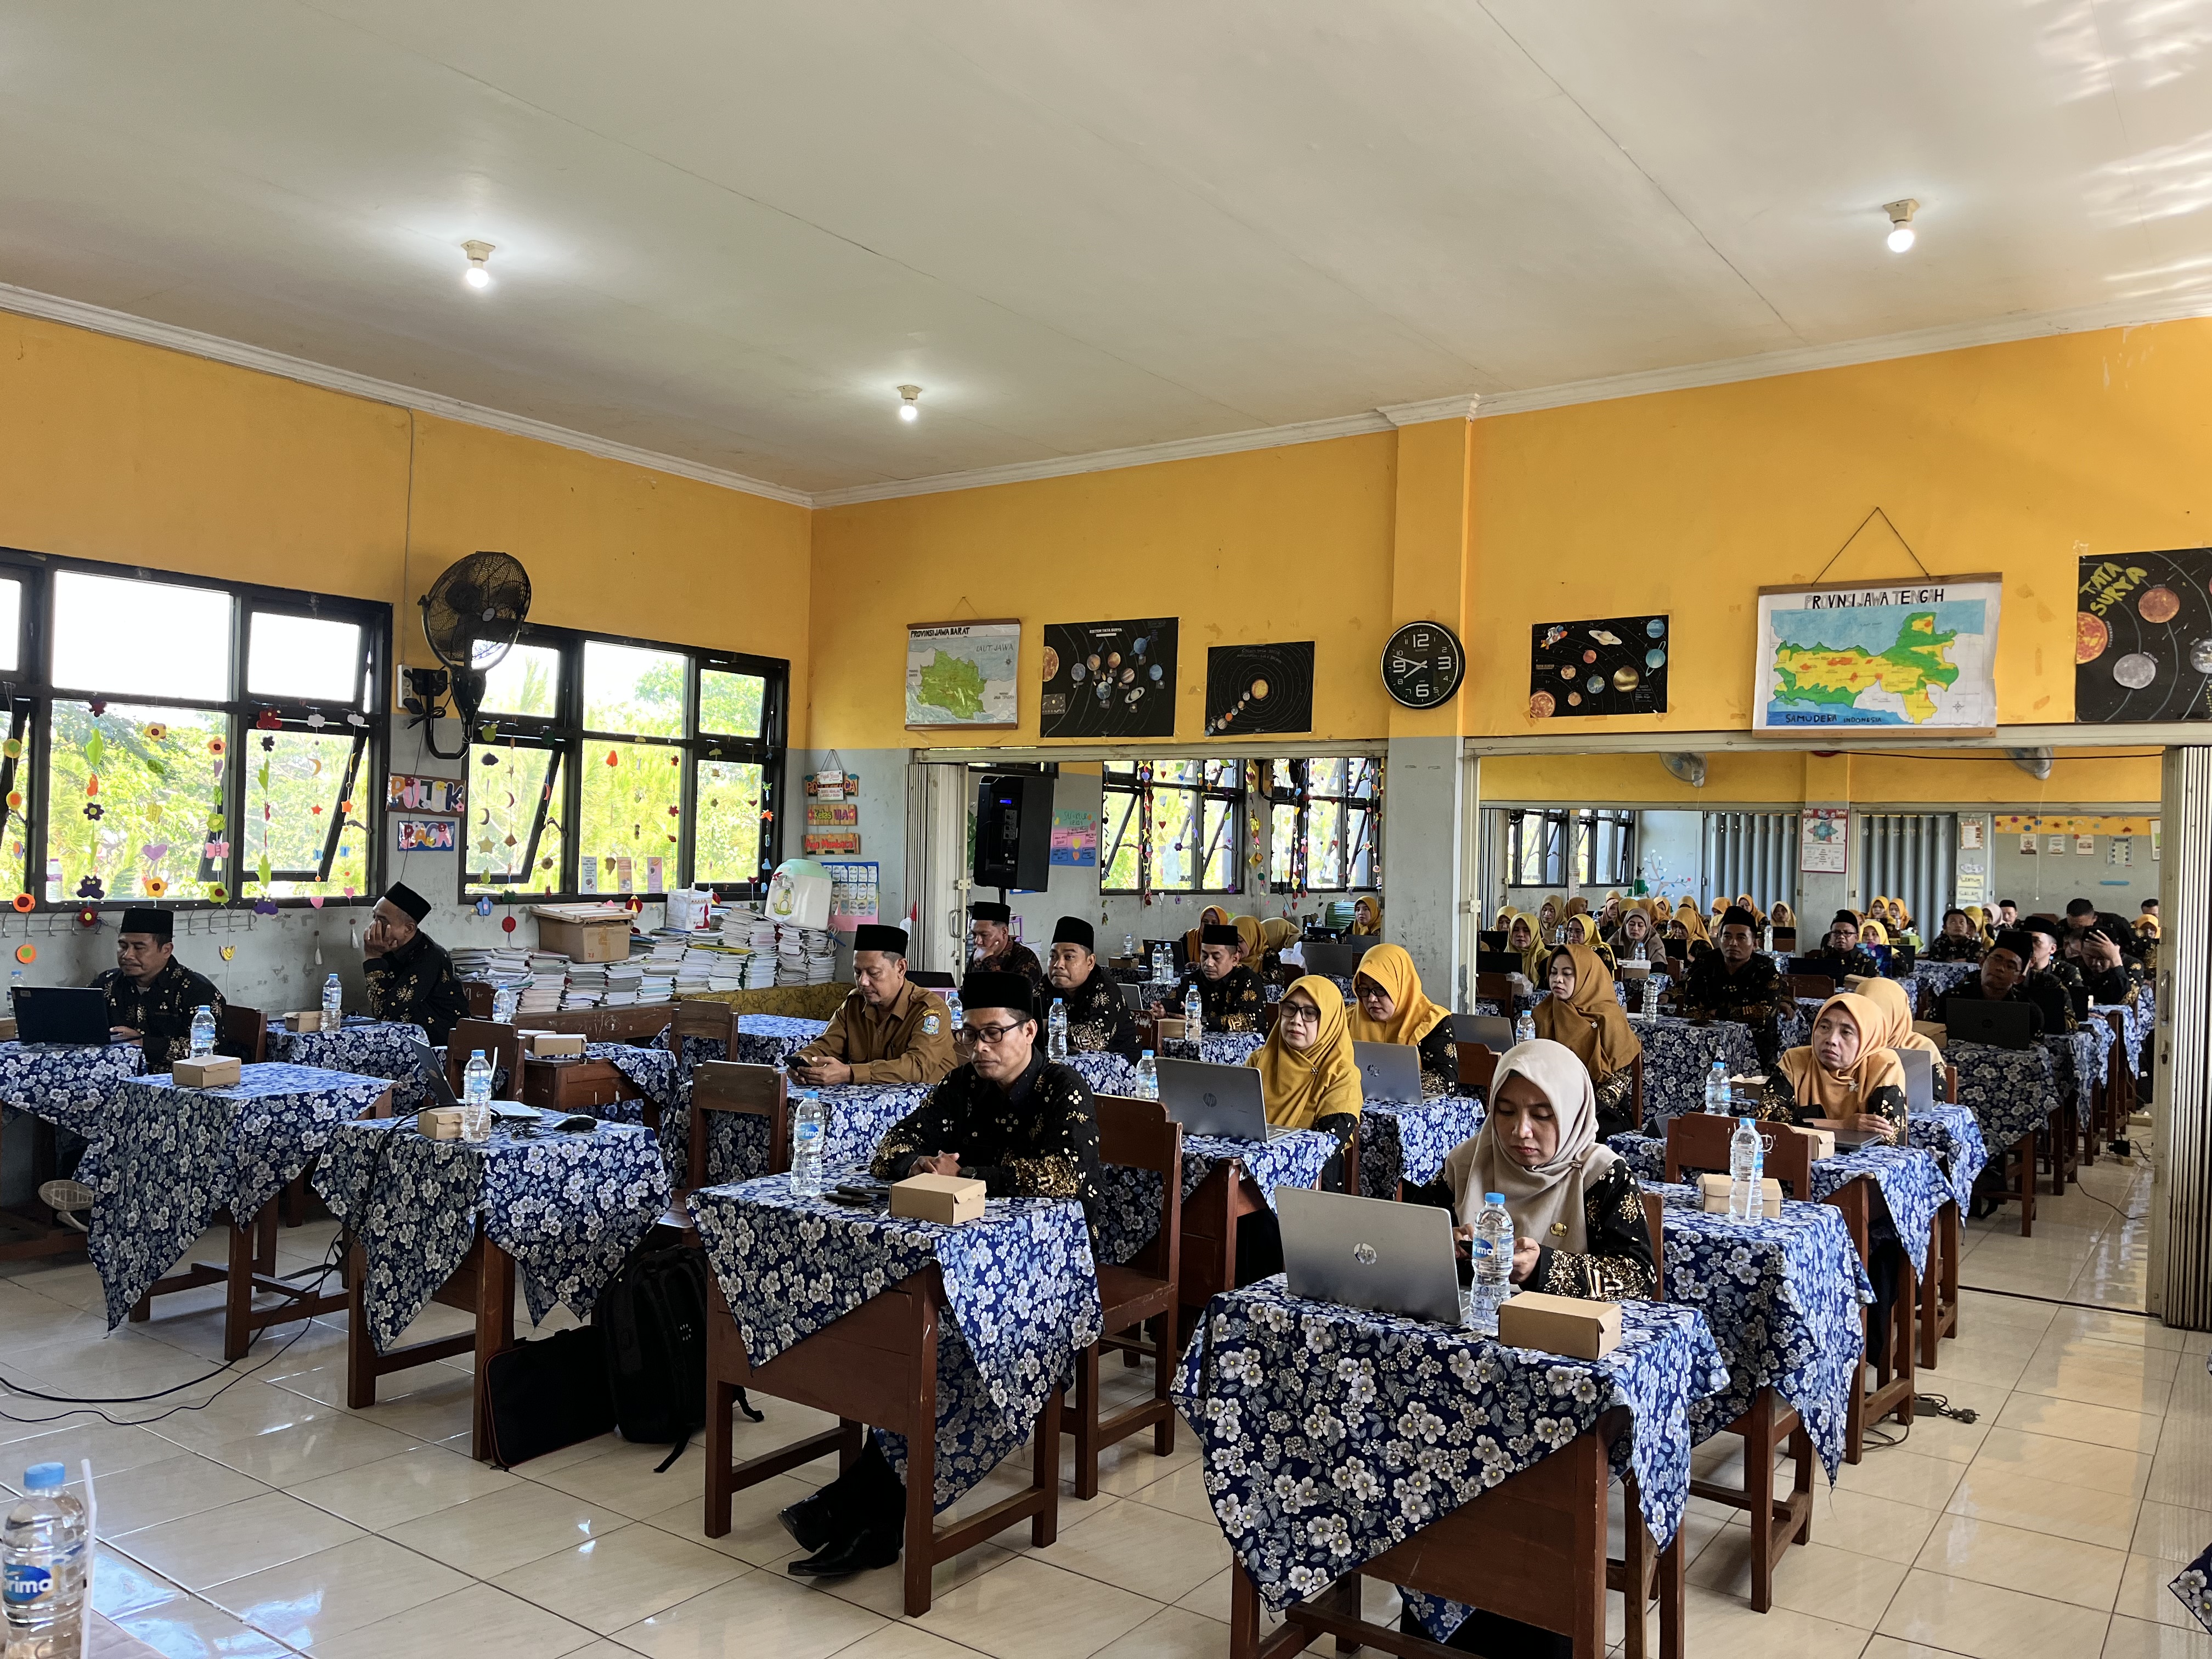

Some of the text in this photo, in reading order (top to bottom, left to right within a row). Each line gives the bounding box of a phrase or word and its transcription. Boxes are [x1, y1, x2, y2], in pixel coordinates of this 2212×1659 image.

[2079, 562, 2123, 594] TATA
[1857, 592, 1889, 607] JAWA
[1892, 589, 1944, 605] TENGAH
[2090, 567, 2147, 616] SURYA
[910, 627, 970, 638] PROVINSI JAWA BARAT
[1413, 634, 1429, 648] 12
[1393, 660, 1406, 673] 9
[1438, 656, 1452, 670] 3
[1416, 684, 1429, 697] 6
[1786, 714, 1837, 723] SAMUDERA
[814, 809, 832, 820] Kelas
[1353, 1243, 1377, 1265] hp
[8, 1576, 54, 1594] rima
